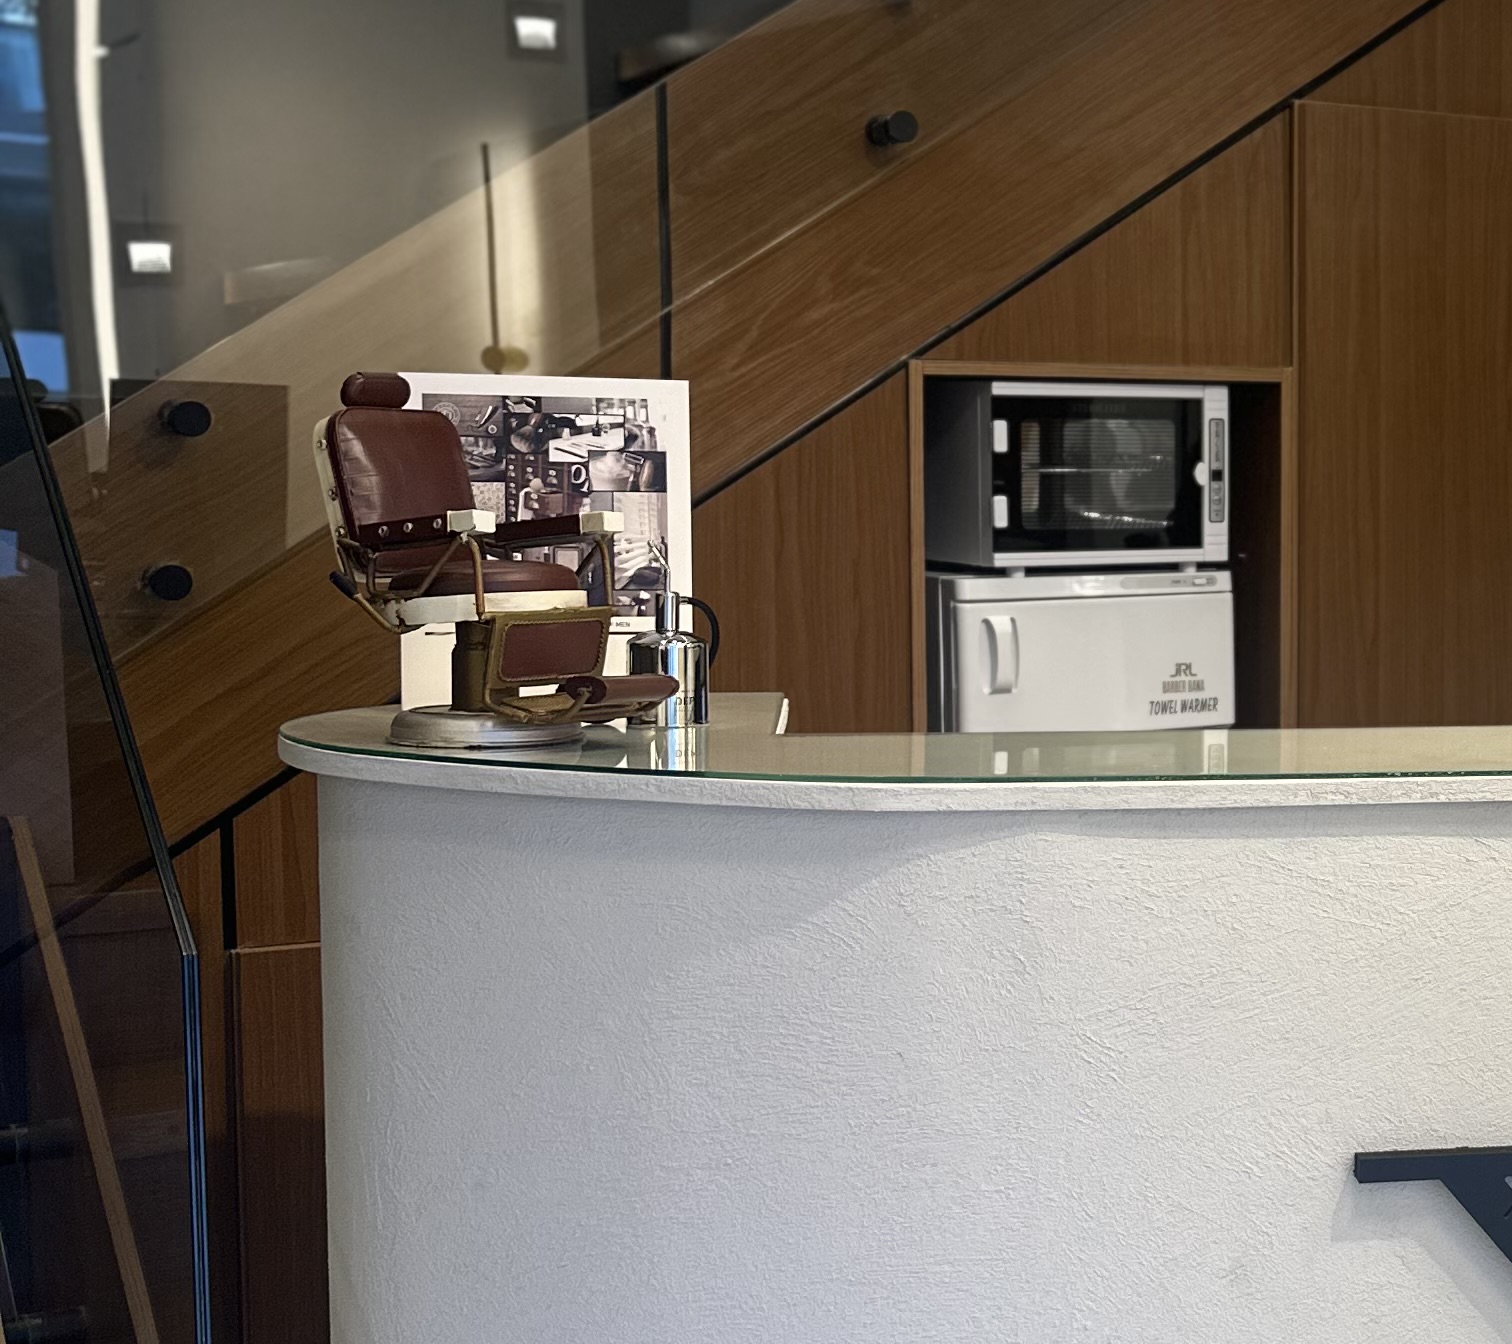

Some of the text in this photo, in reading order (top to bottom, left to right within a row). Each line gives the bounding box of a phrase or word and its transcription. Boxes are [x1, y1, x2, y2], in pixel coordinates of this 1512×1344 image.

[1169, 662, 1198, 678] JRL
[1149, 697, 1219, 716] TOWEL WARMER
